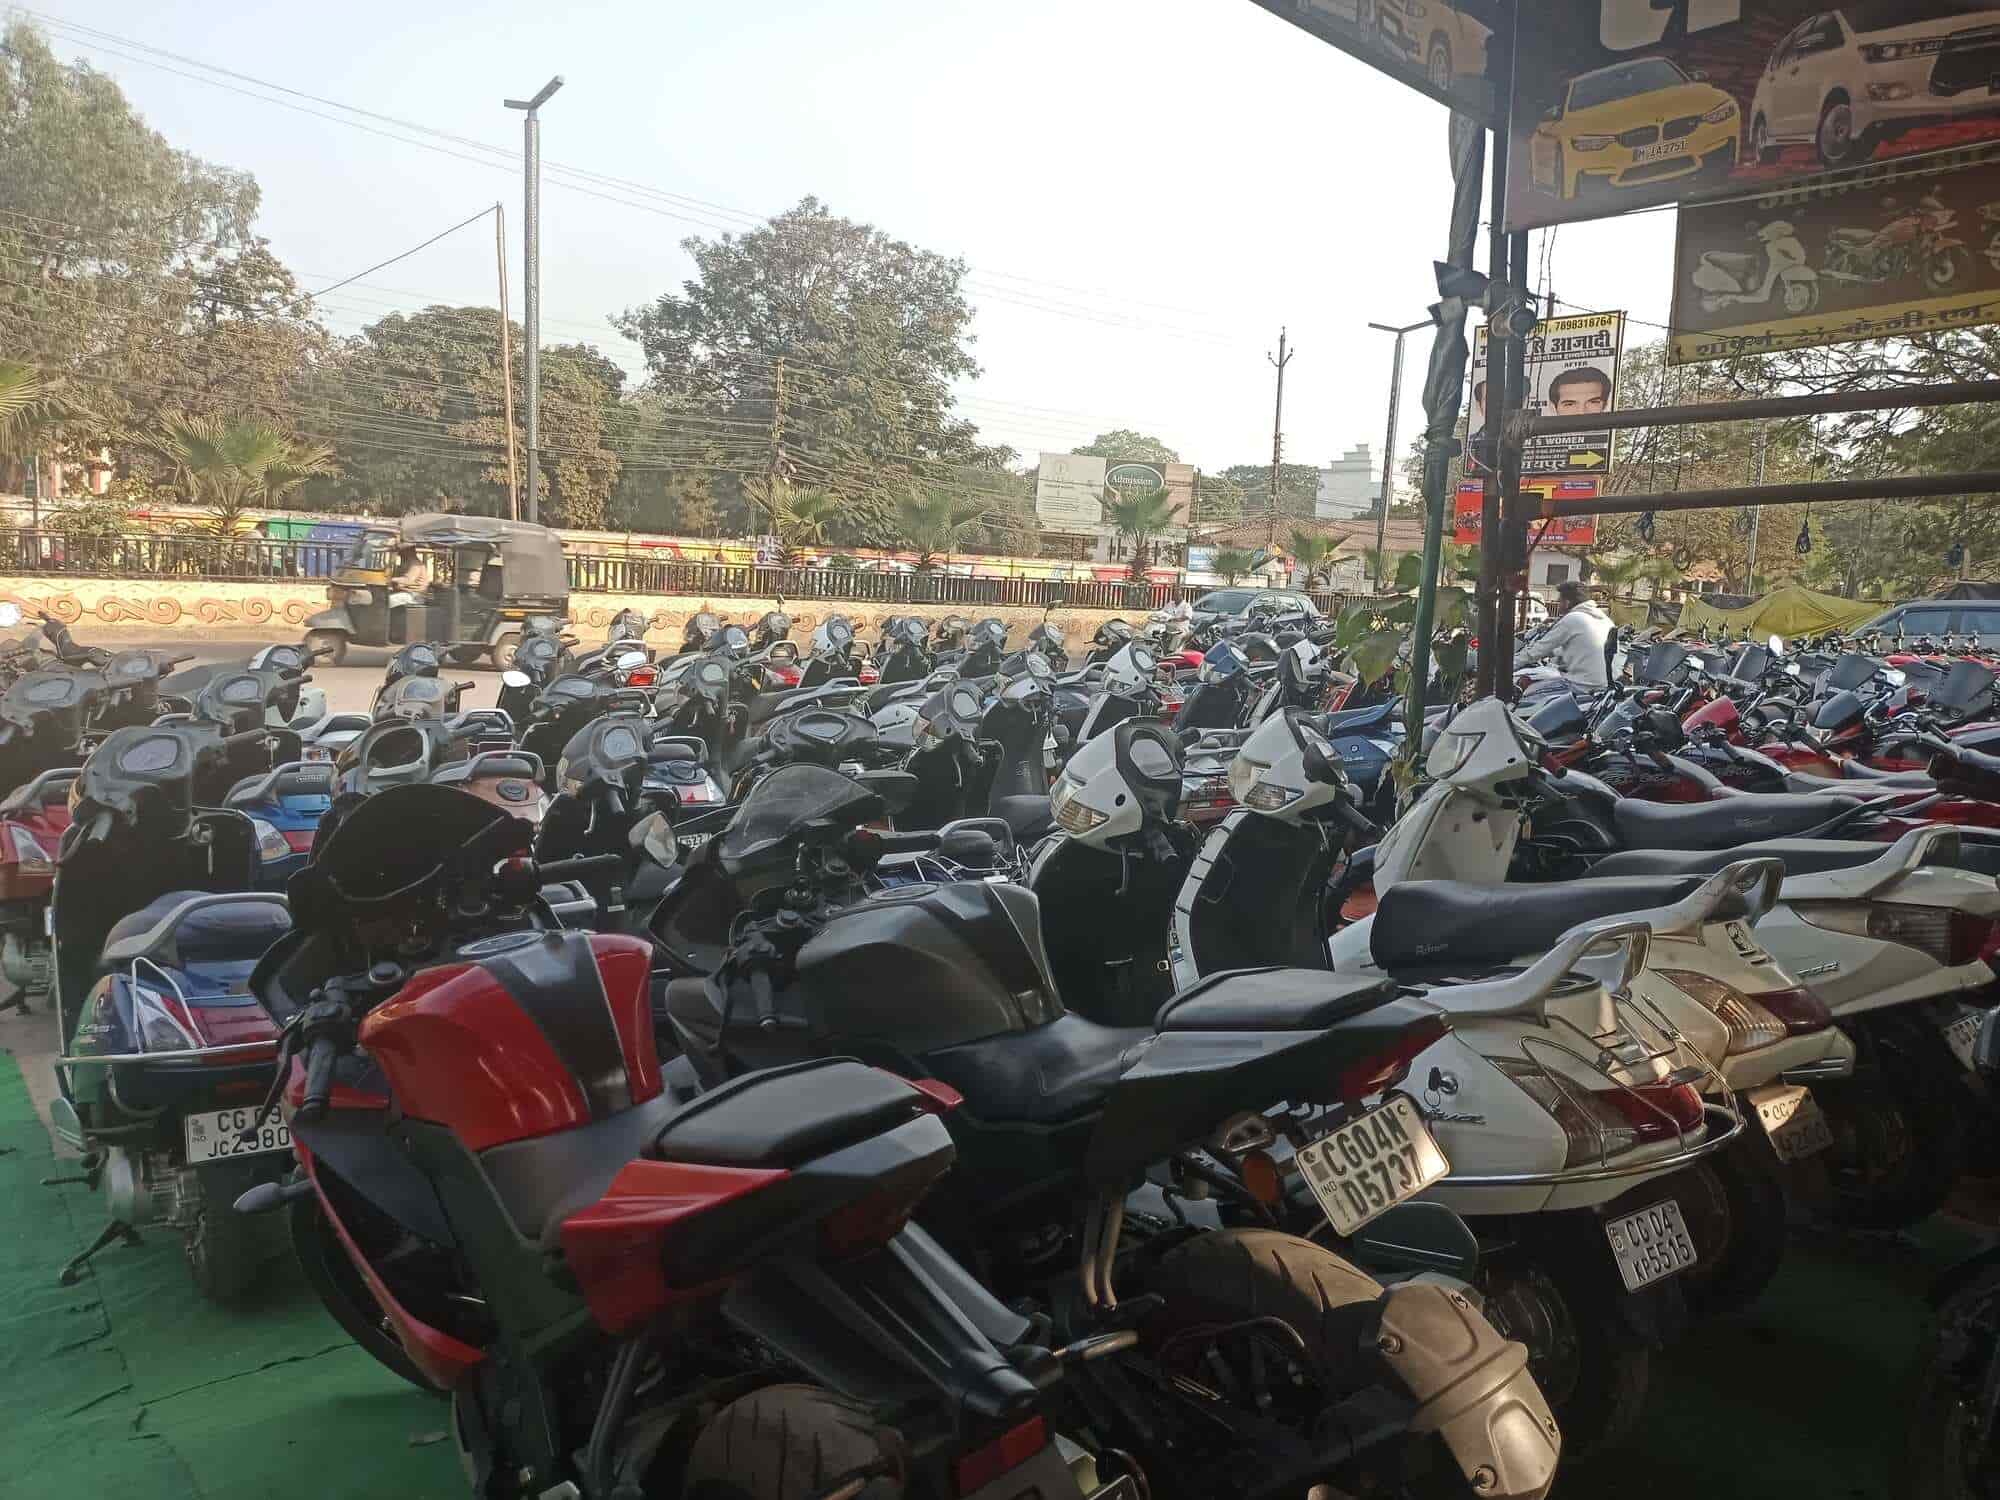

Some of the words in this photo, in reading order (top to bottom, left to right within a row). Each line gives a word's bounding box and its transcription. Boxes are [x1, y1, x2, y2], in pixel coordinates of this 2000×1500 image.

[1551, 329, 1611, 353] आजादी
[1546, 435, 1585, 446] WOMEN
[217, 1110, 246, 1133] CG
[1319, 1180, 1338, 1198] IND
[1340, 1143, 1424, 1217] D5737
[1626, 1217, 1650, 1247] CG
[1649, 1207, 1673, 1238] 04
[1632, 1233, 1690, 1282] KP5515
